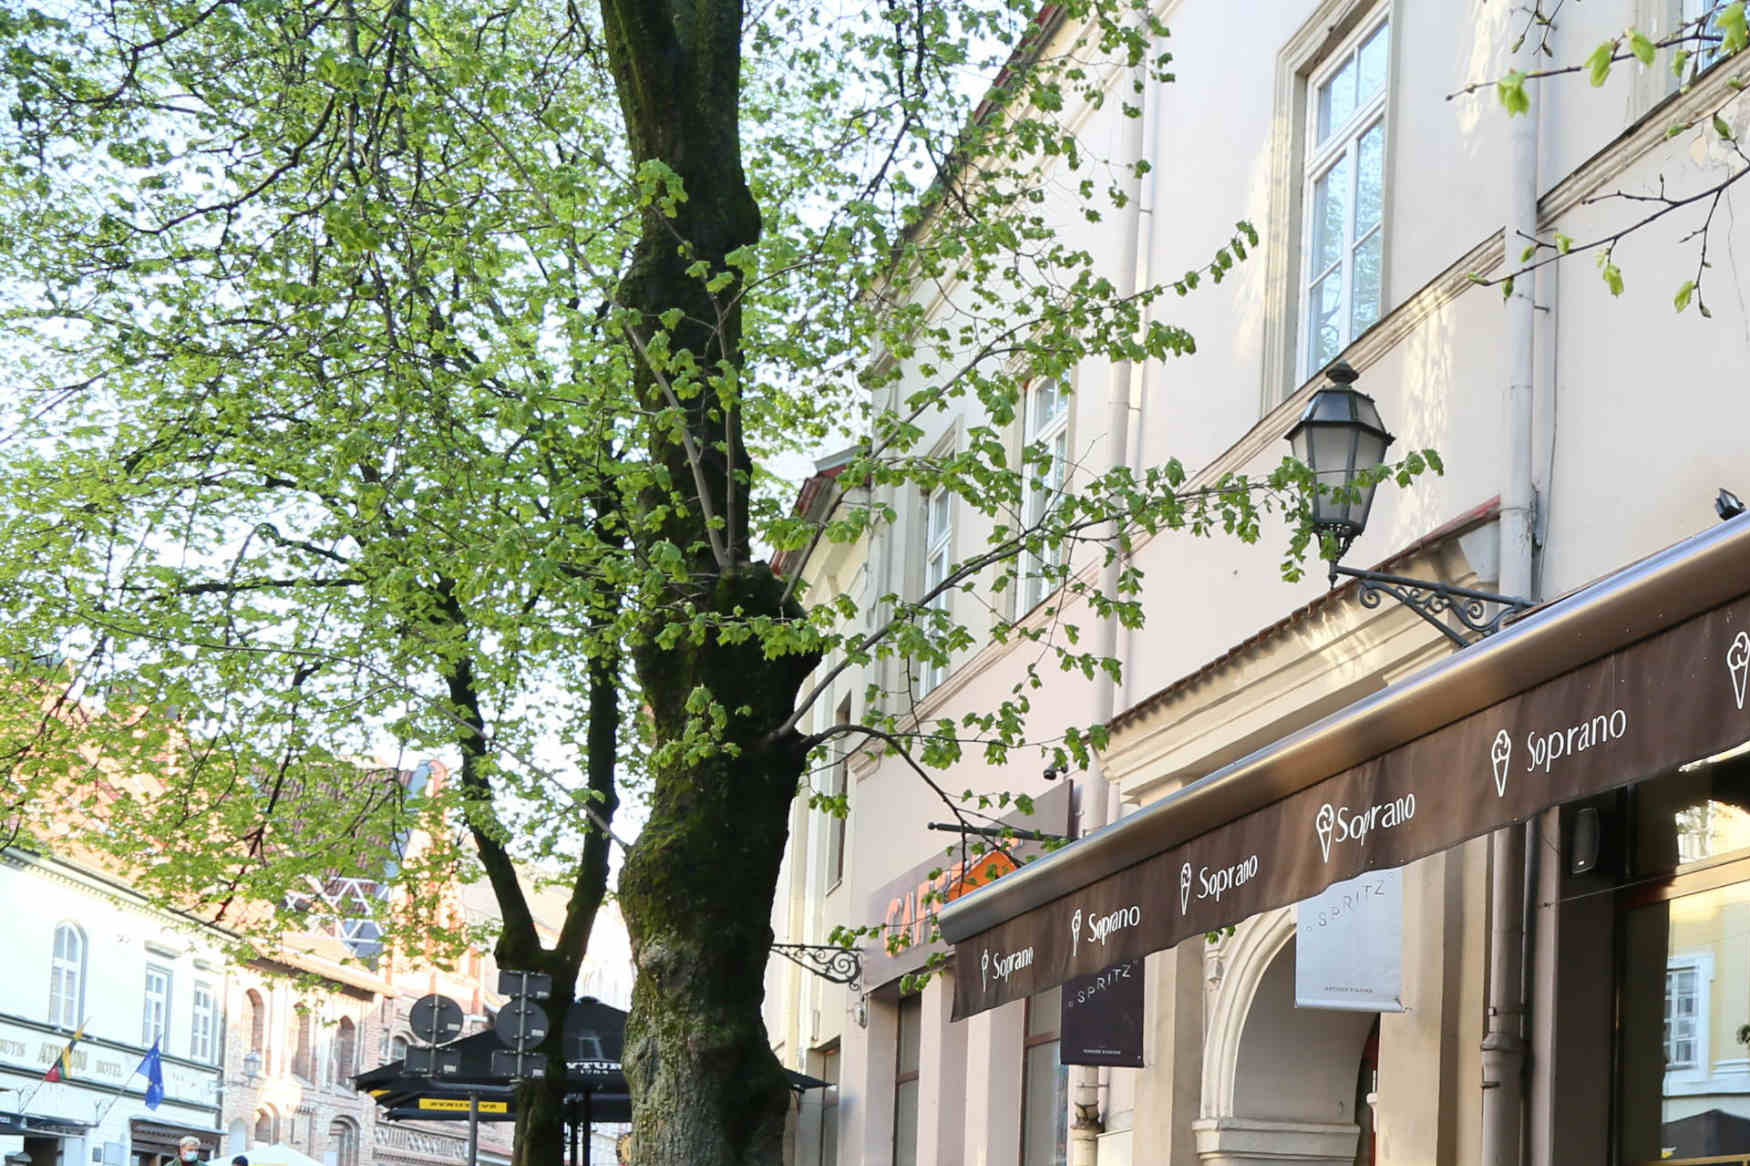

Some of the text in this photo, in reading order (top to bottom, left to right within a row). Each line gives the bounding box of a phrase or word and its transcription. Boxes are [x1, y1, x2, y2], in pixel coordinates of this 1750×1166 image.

[1527, 709, 1627, 773] Soprano
[1334, 793, 1416, 846] Soprano
[1197, 855, 1258, 902] Soprano
[1087, 905, 1140, 946] Soprano
[1318, 879, 1385, 927] SPRITZ
[992, 946, 1034, 983] Soprano
[1077, 964, 1131, 1003] SPRITZ
